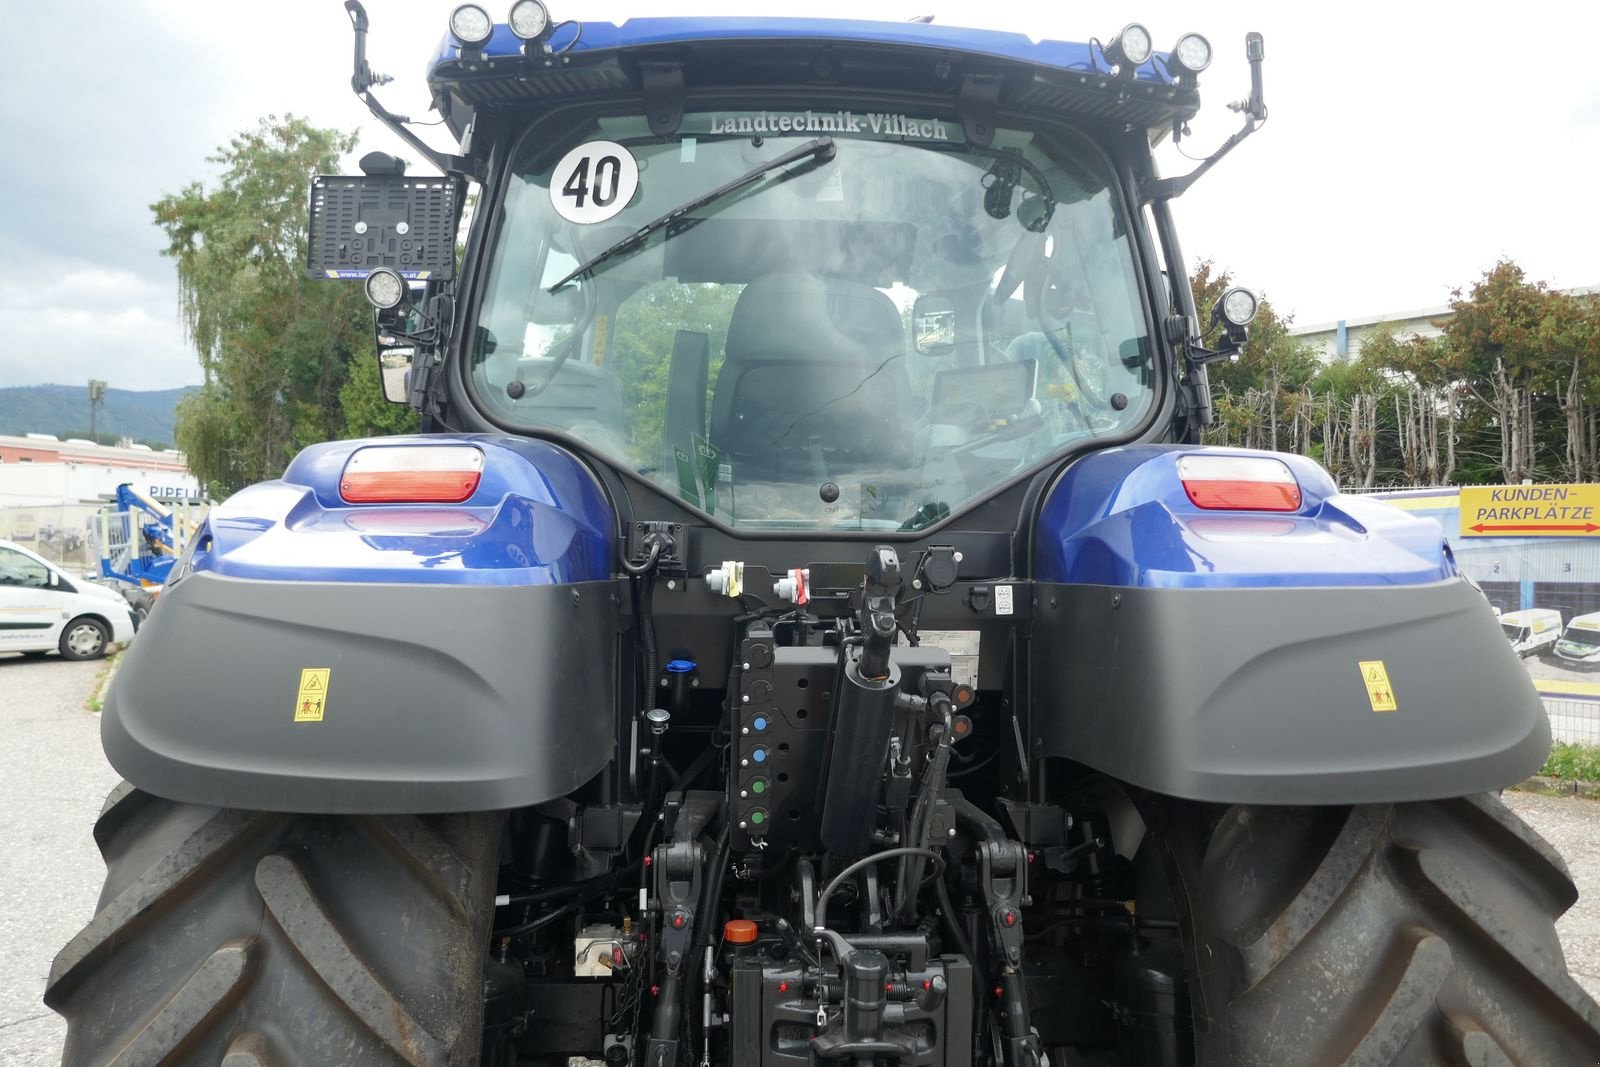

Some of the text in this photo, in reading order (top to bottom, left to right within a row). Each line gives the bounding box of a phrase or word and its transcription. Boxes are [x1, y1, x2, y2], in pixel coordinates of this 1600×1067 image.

[710, 110, 948, 140] Landtechnik-Villach
[562, 155, 621, 208] 40
[1491, 488, 1578, 502] KUNDEN-
[1477, 503, 1594, 520] PARKPLÄTZE
[1493, 565, 1500, 573] 2
[1563, 563, 1571, 572] 3
